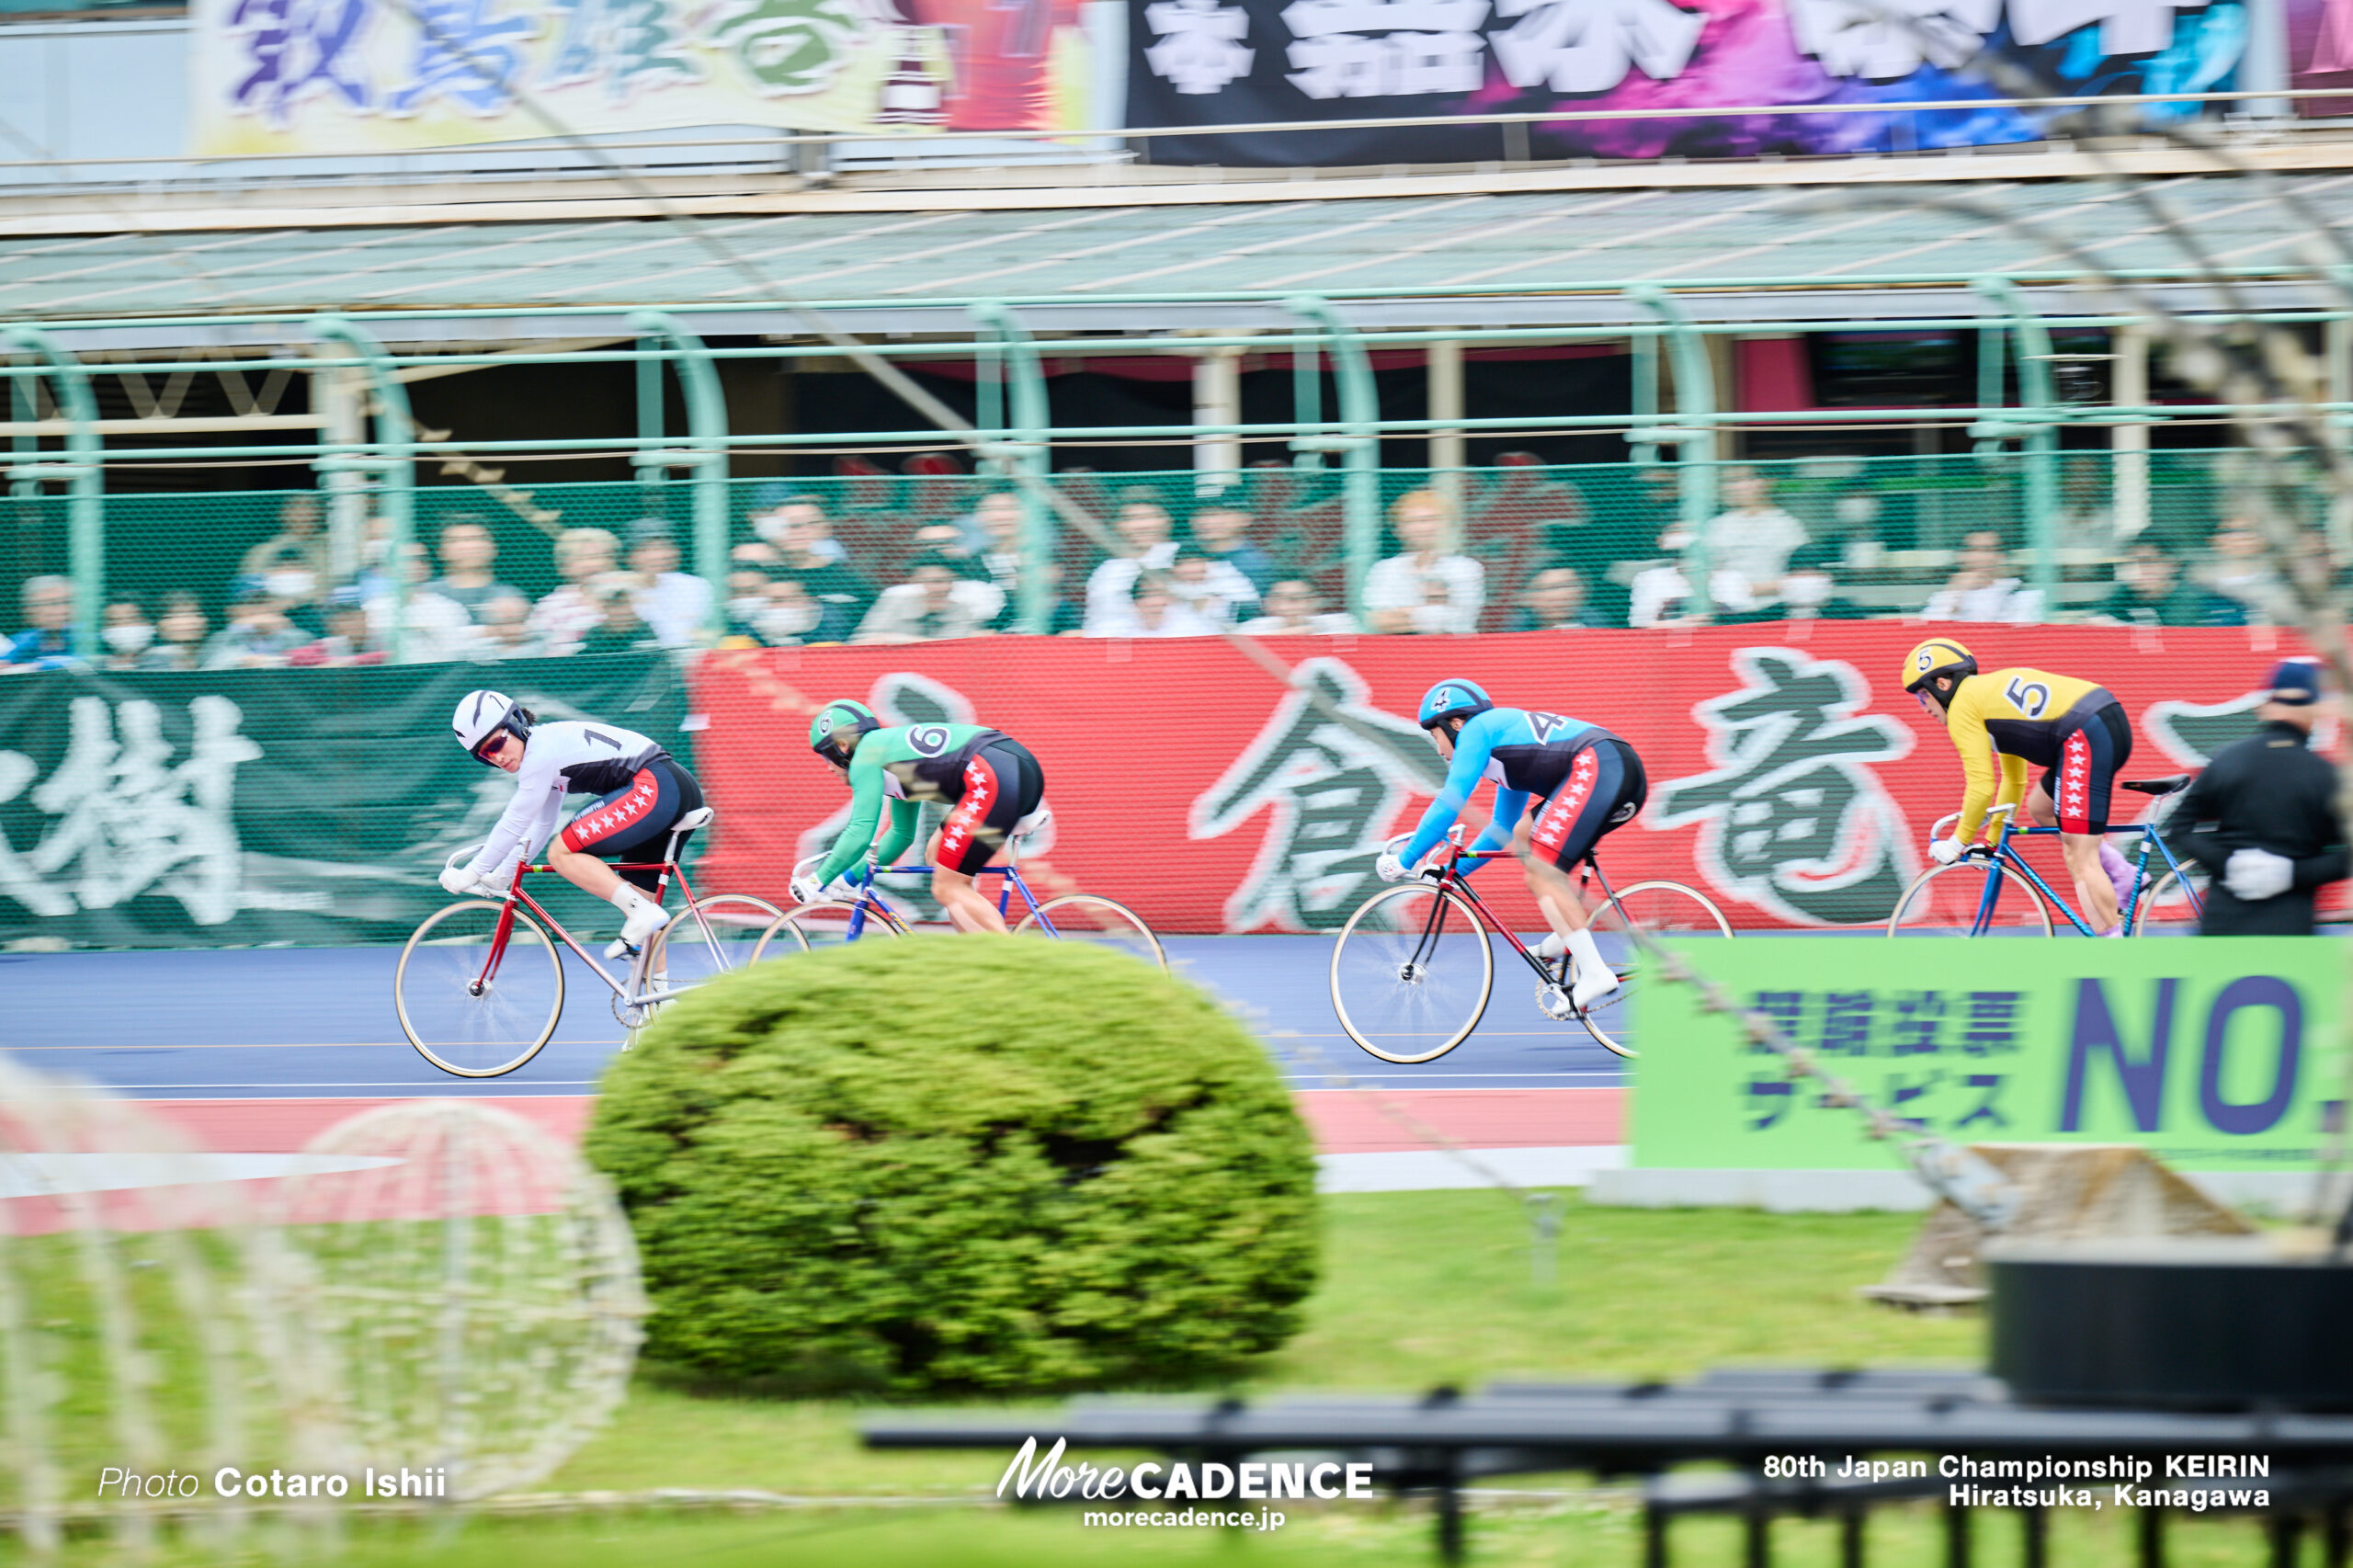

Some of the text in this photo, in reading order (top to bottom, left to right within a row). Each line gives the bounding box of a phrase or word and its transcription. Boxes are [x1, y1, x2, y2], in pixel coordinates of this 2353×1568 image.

[1916, 647, 1934, 673] 5
[1430, 687, 1451, 712] 4
[2003, 675, 2052, 721] 5
[818, 710, 834, 736] 6
[1523, 711, 1568, 746] 4
[583, 728, 622, 752] 1
[904, 723, 952, 759] 6
